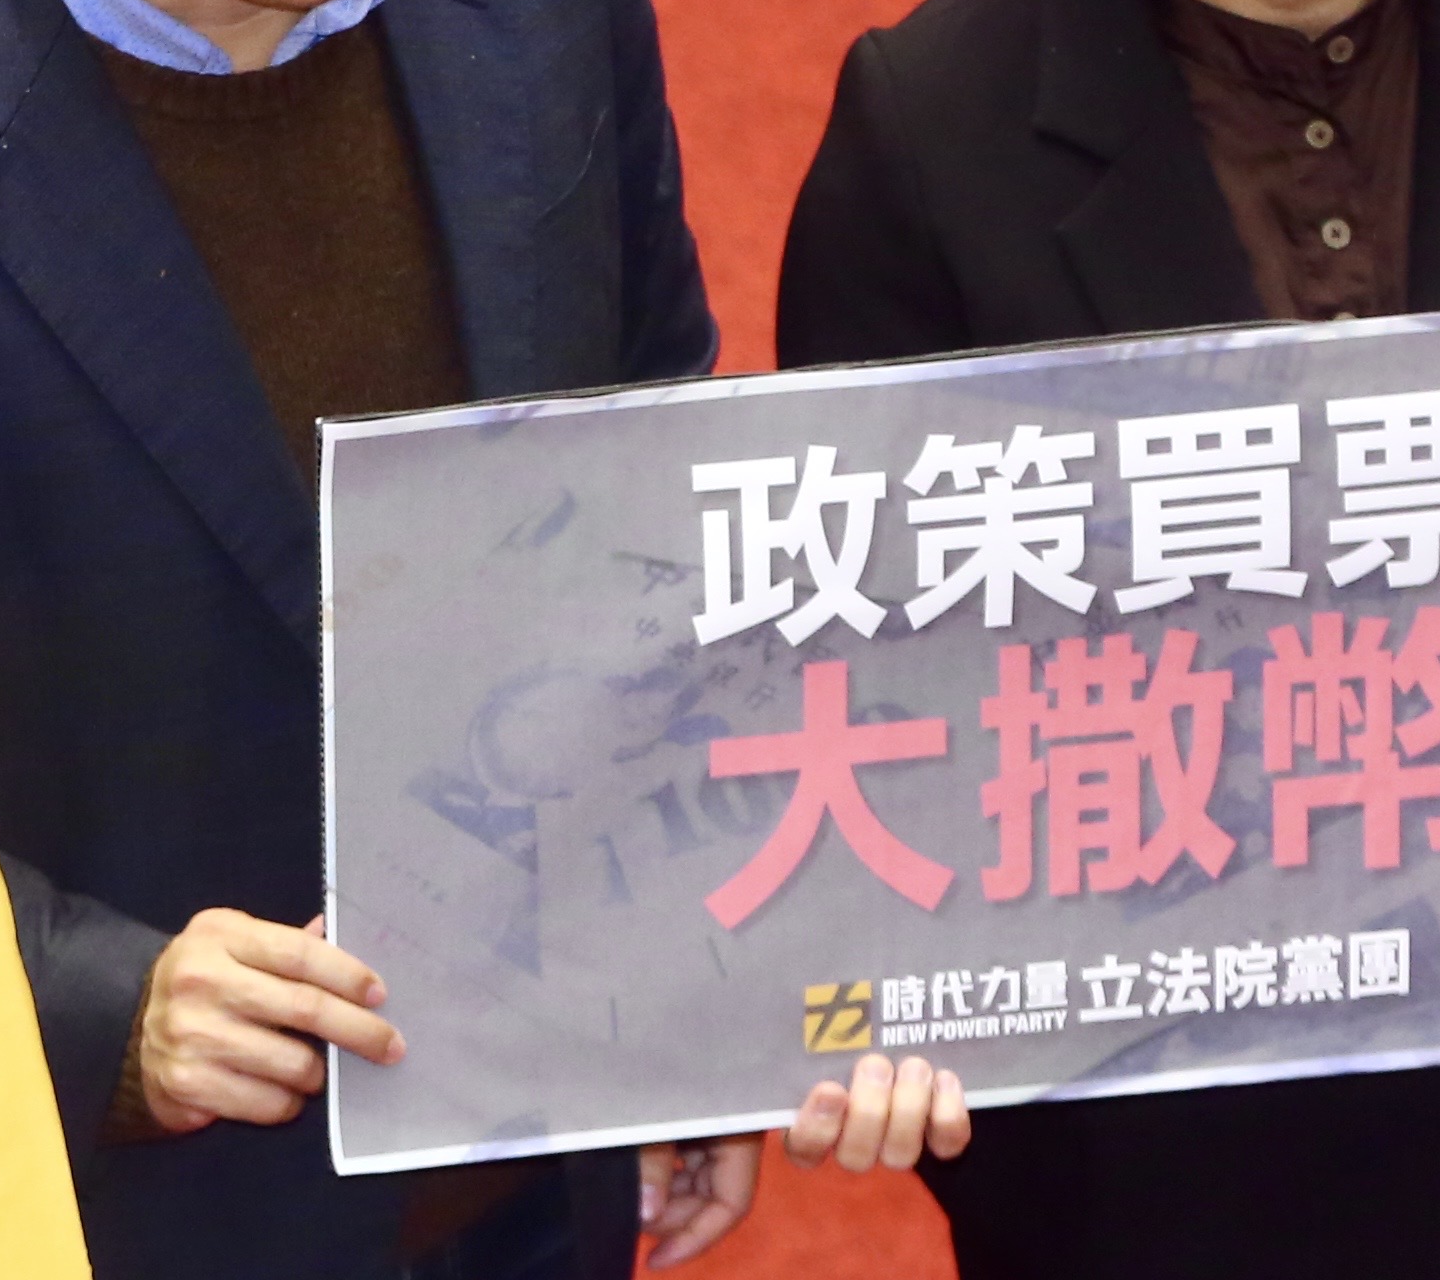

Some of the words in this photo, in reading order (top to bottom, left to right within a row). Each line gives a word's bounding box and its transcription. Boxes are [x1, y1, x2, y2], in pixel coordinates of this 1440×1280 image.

[881, 960, 1068, 1022] 時代力量
[1078, 929, 1410, 1023] 立法院黨團
[881, 1023, 927, 1046] NEW
[929, 1016, 999, 1042] POWER
[1003, 1010, 1068, 1035] PARTY
